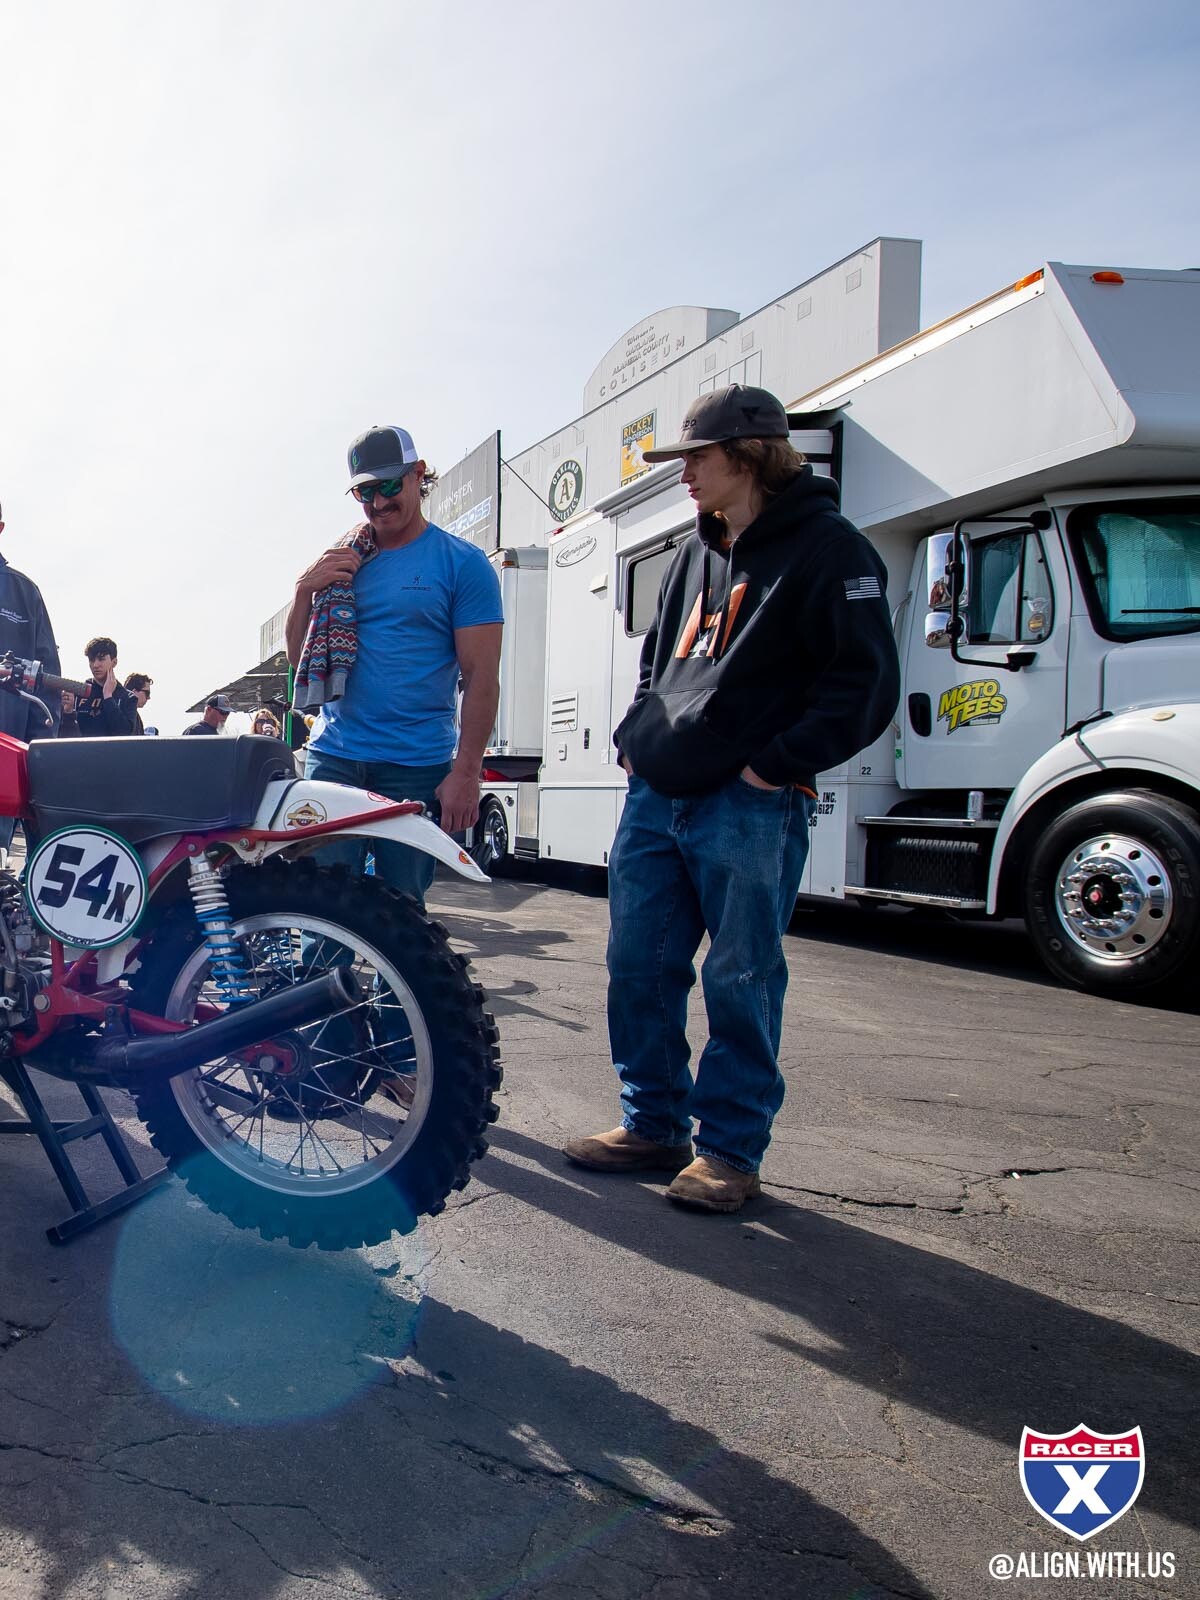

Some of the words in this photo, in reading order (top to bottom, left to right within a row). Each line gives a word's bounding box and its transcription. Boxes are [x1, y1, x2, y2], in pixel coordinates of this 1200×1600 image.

[642, 332, 670, 356] COUNTY
[599, 335, 685, 397] COLISEUM
[623, 414, 653, 439] RICKEY
[552, 461, 579, 485] OAKLAND
[938, 680, 999, 719] MOTO
[948, 695, 1006, 731] TEES
[861, 766, 871, 776] 22
[822, 791, 836, 803] INC.
